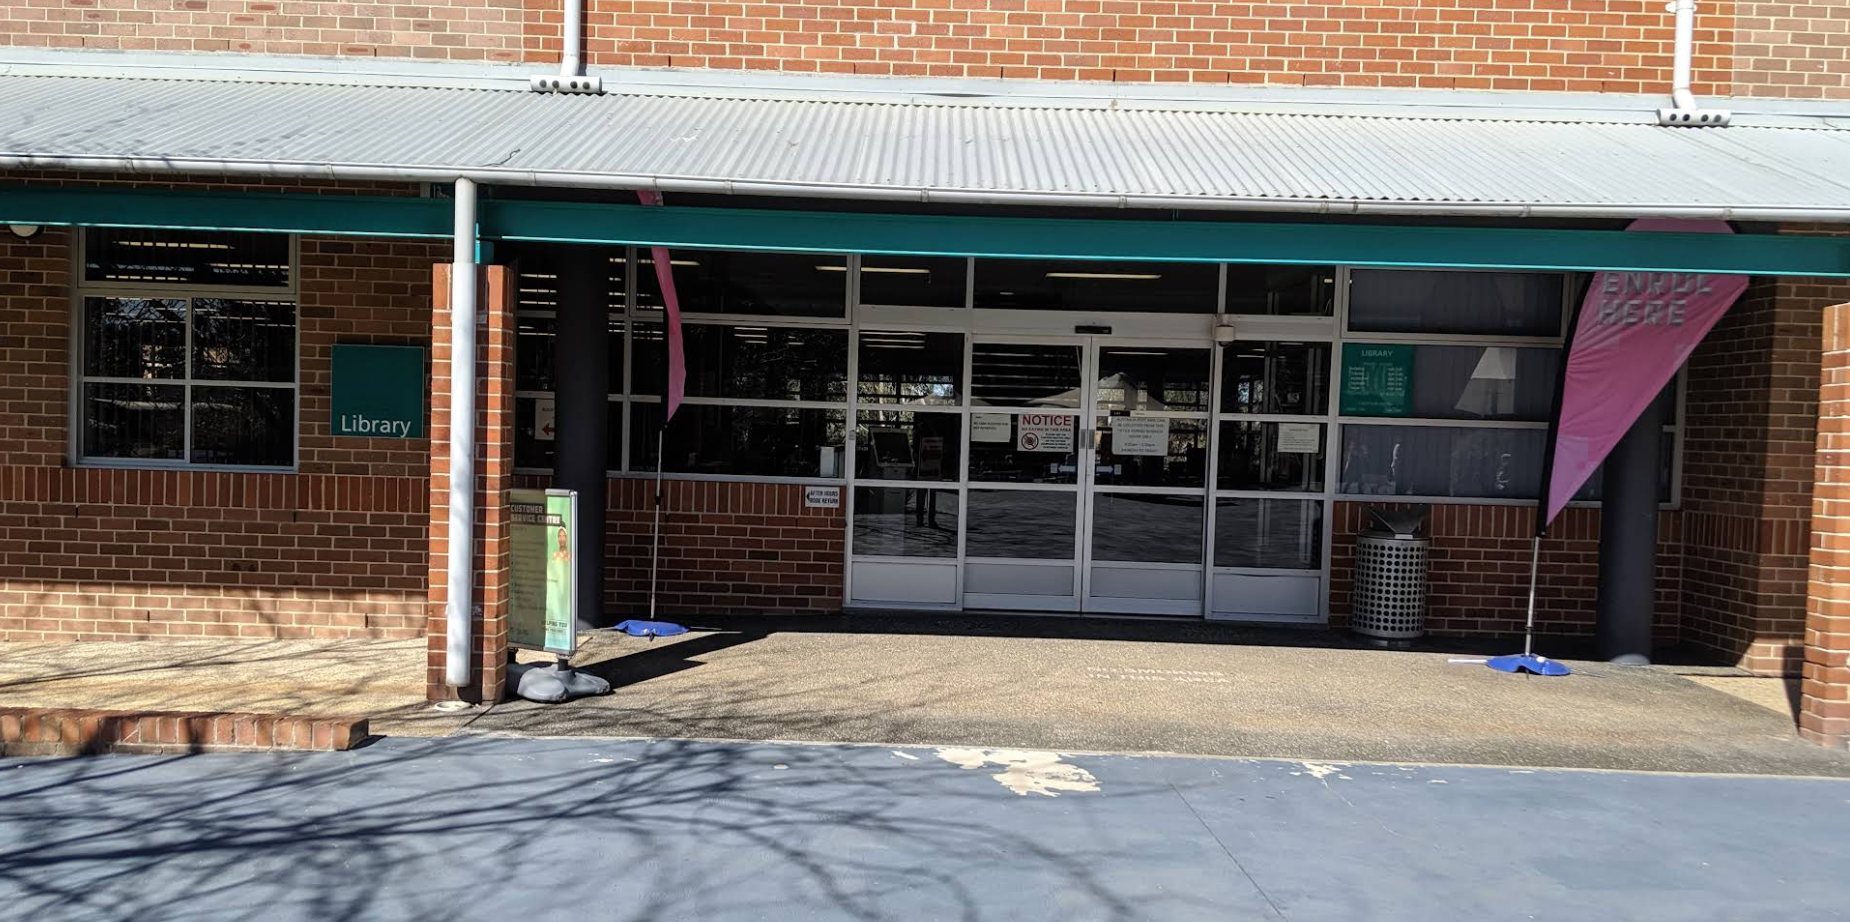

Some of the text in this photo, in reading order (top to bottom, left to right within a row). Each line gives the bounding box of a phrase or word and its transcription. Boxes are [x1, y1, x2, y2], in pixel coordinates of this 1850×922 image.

[1600, 300, 1687, 325] HERE
[1361, 349, 1394, 357] LIBRARY
[1022, 414, 1071, 426] NOTICE
[341, 414, 411, 438] Library
[510, 504, 543, 513] CUSTOMER
[511, 514, 560, 524] SERVICE CENTRE
